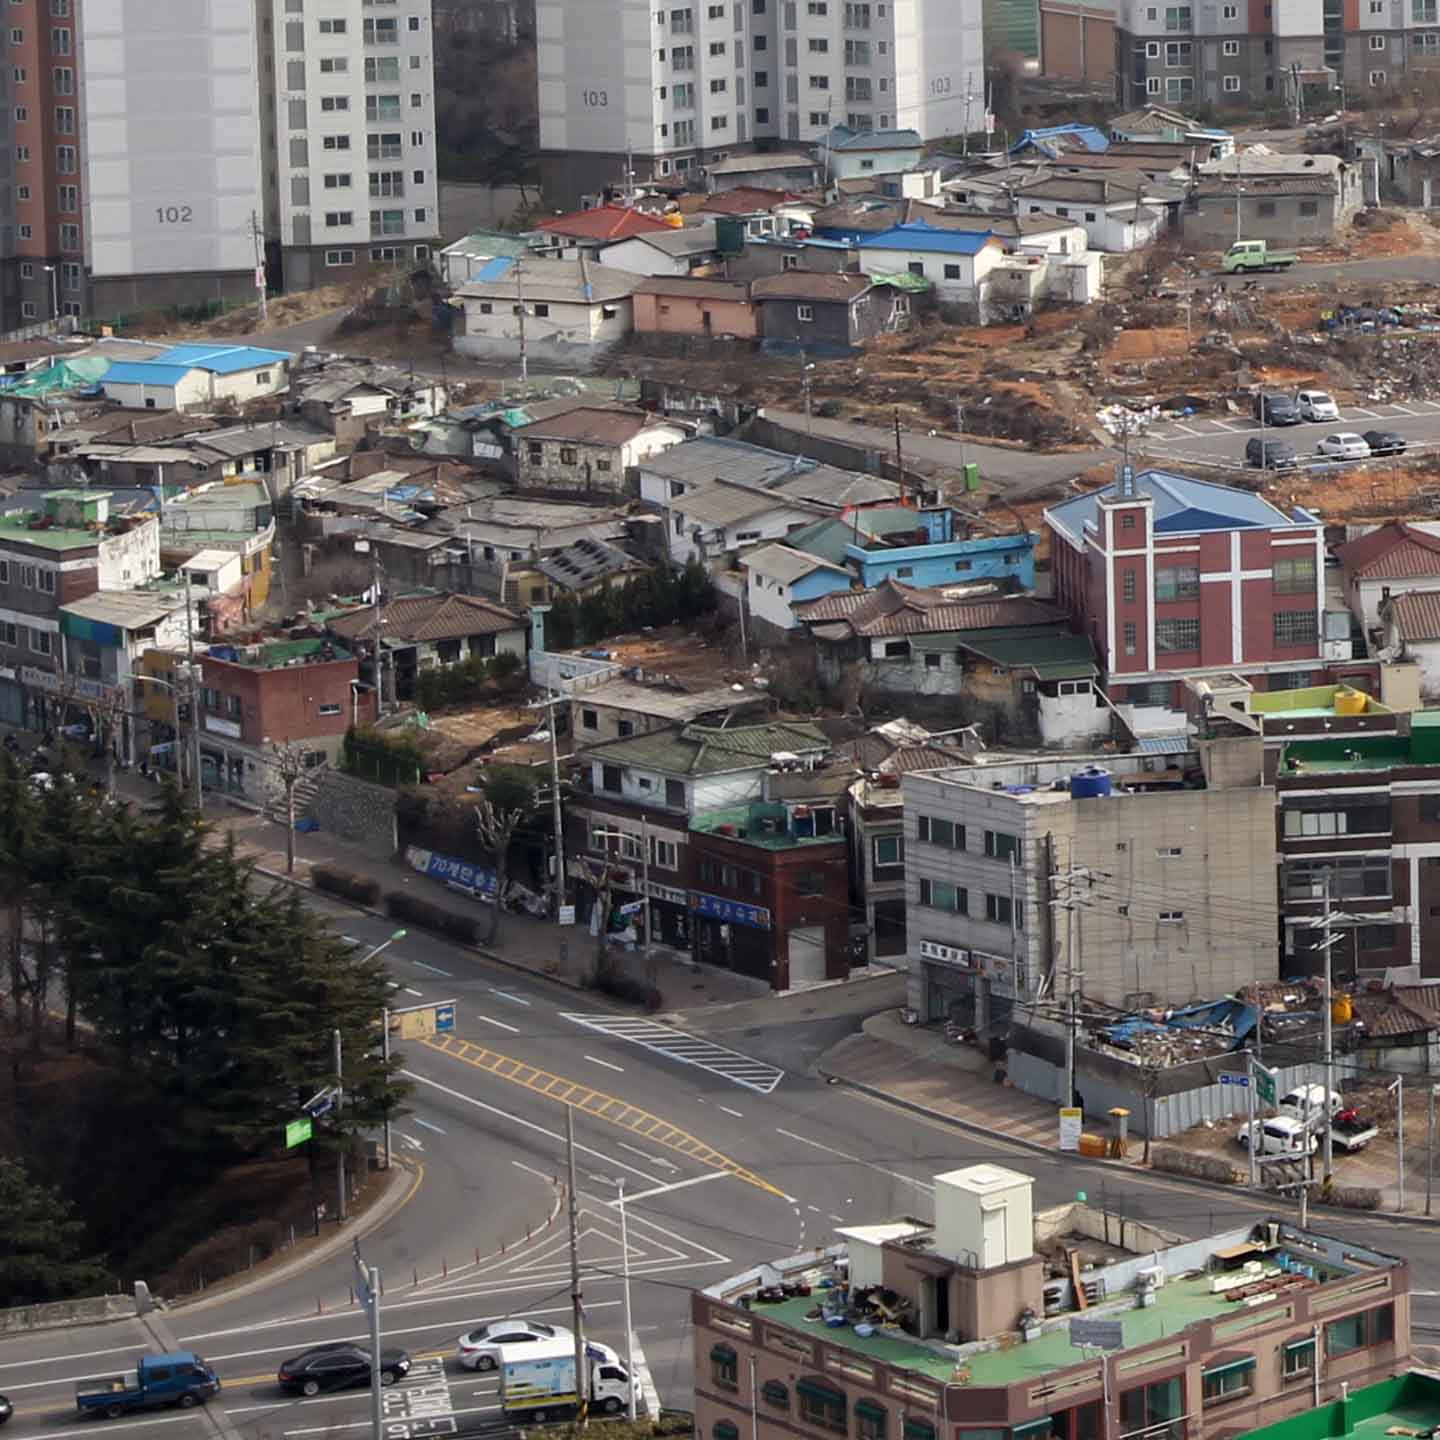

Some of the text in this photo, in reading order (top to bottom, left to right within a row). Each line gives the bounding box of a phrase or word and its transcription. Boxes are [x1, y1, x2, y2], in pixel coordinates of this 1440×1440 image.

[931, 77, 951, 95] 103
[584, 90, 608, 107] 103
[156, 206, 193, 223] 102
